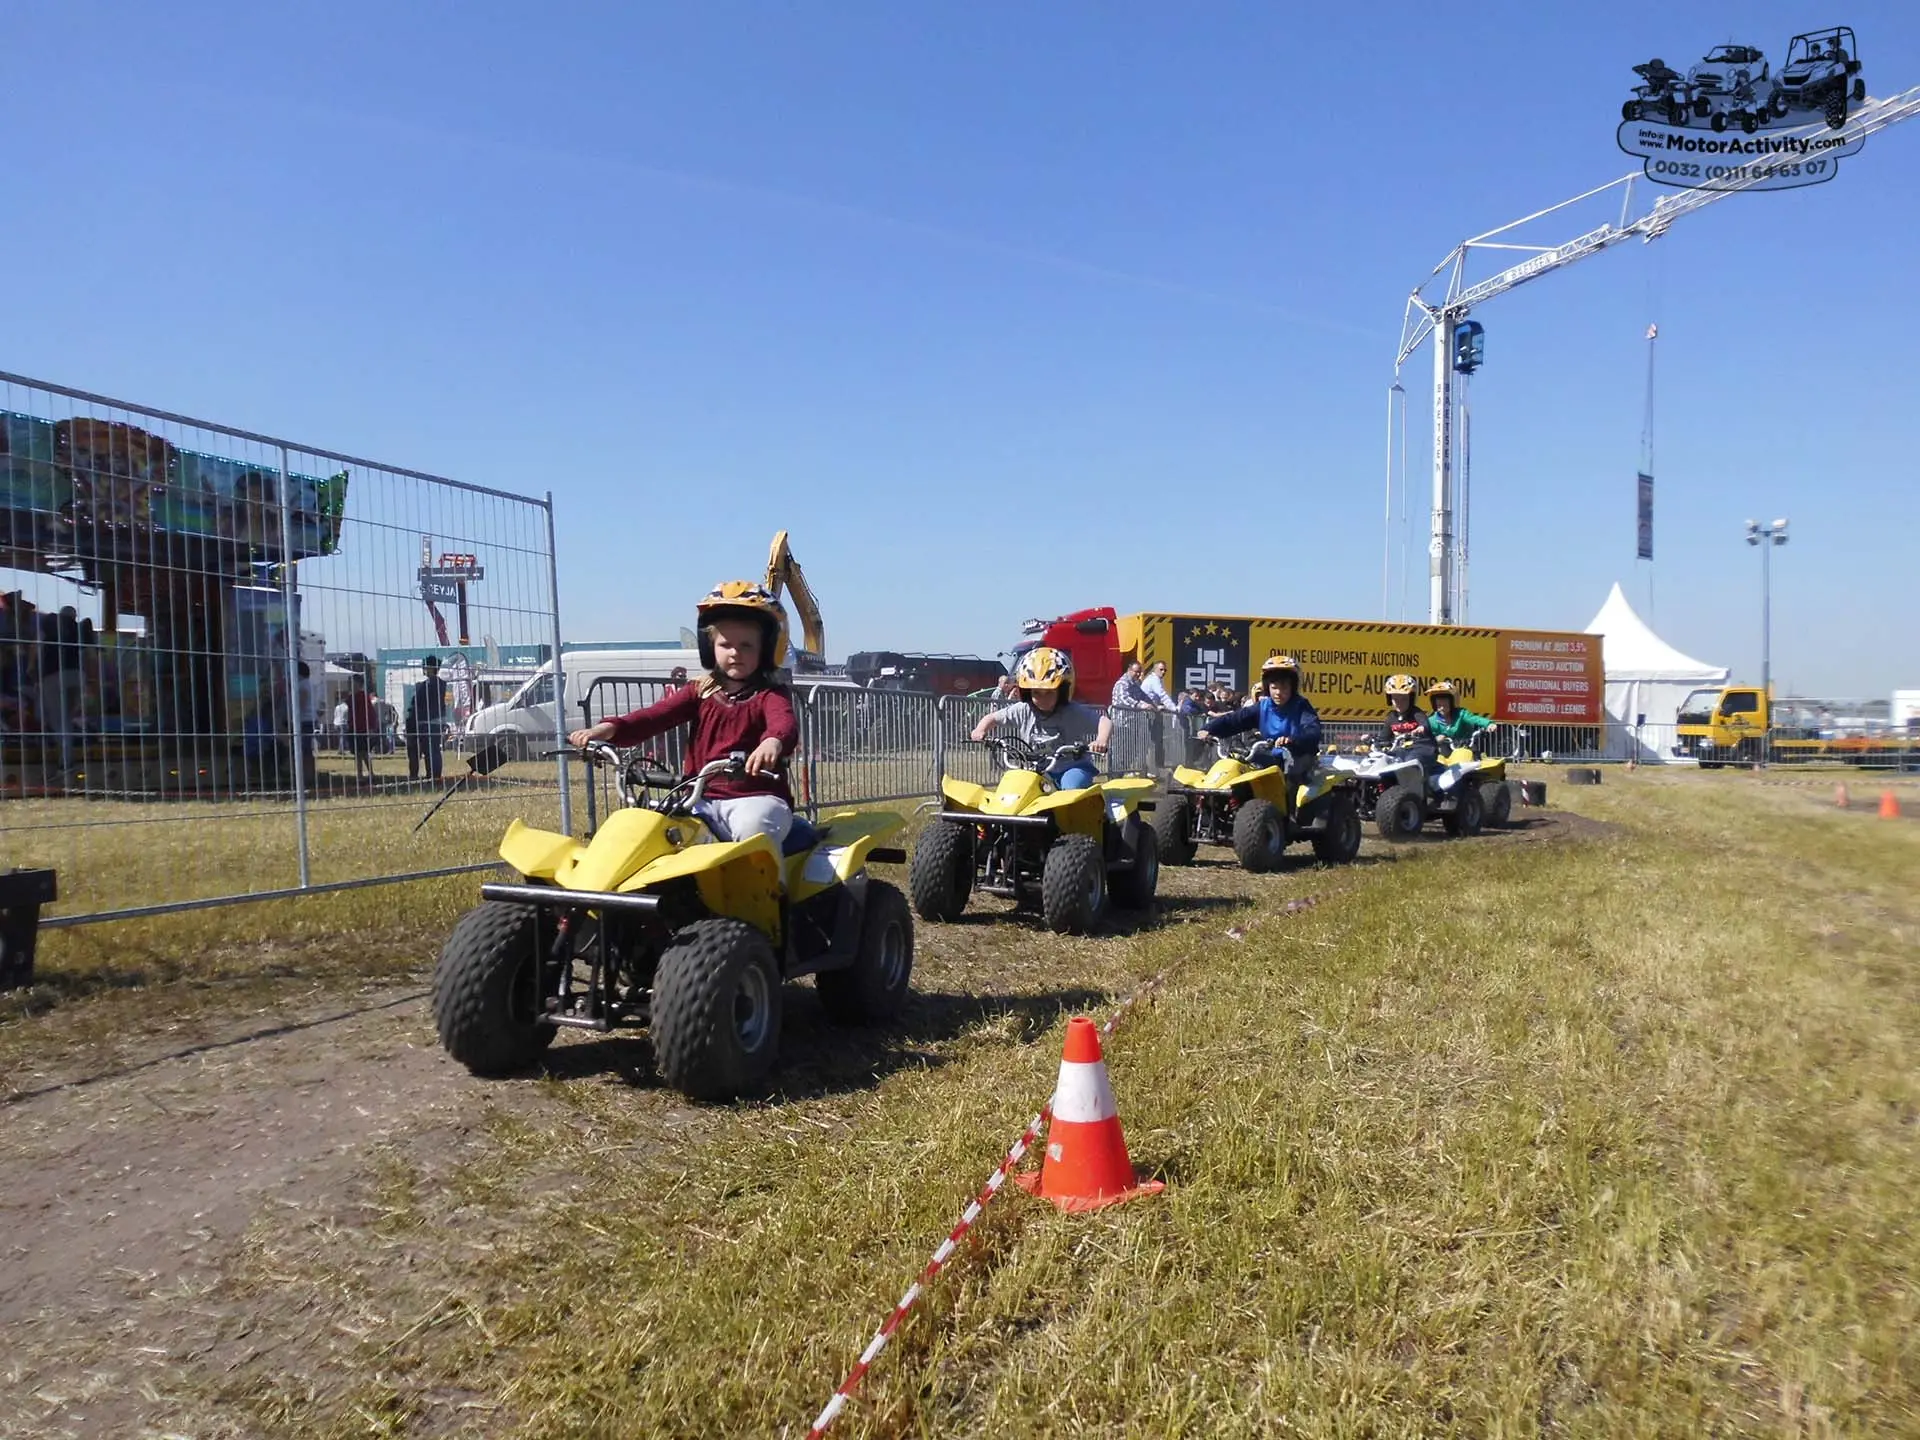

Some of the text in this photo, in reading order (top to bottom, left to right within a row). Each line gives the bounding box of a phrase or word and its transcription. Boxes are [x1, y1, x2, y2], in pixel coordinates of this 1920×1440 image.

[1310, 649, 1366, 666] EQUIPMENT
[1370, 652, 1419, 667] AUCTIONS
[1556, 661, 1585, 672] AUCTION
[1562, 681, 1589, 692] BUYERS
[1507, 702, 1516, 713] A2
